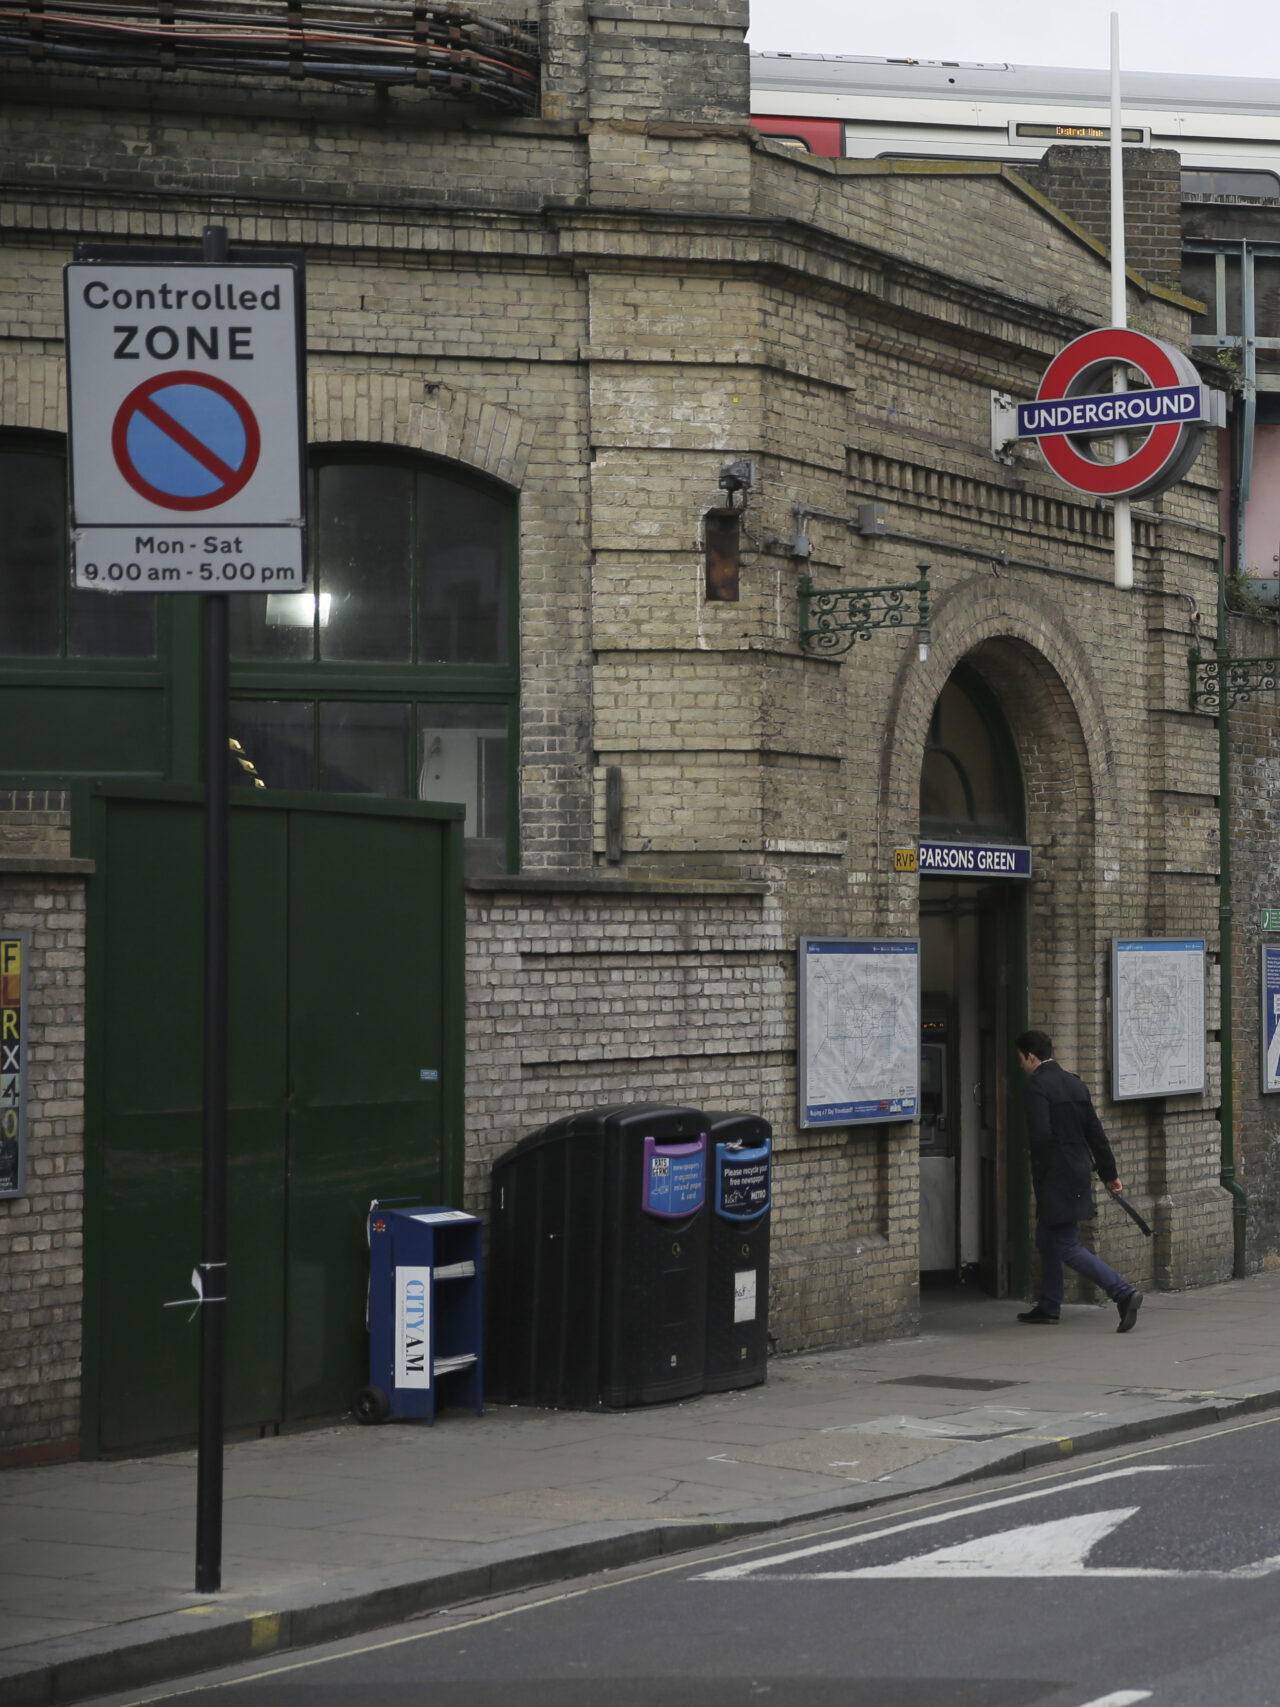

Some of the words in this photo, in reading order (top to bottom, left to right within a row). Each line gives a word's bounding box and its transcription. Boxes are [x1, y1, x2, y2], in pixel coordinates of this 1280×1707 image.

[1088, 127, 1104, 137] line
[83, 281, 281, 311] Controlled
[113, 325, 254, 360] ZONE
[1023, 393, 1196, 430] UNDERGROUND
[135, 536, 185, 554] Mon
[203, 536, 244, 554] Sat
[84, 562, 142, 581] 9.00
[147, 569, 181, 581] am
[199, 562, 255, 581] 5.00
[261, 568, 295, 583] pm
[896, 853, 915, 867] RVP
[919, 847, 975, 868] PARSONS
[977, 851, 1016, 871] GREEN
[654, 1158, 668, 1167] RATS
[724, 1168, 743, 1177] Please
[743, 1166, 759, 1176] recycle
[759, 1165, 768, 1175] your
[674, 1182, 689, 1191] mixed
[729, 1178, 741, 1186] free
[741, 1175, 765, 1185] newspaper
[750, 1189, 767, 1201] METRO
[406, 1280, 425, 1333] CITY
[406, 1335, 425, 1376] A.M.
